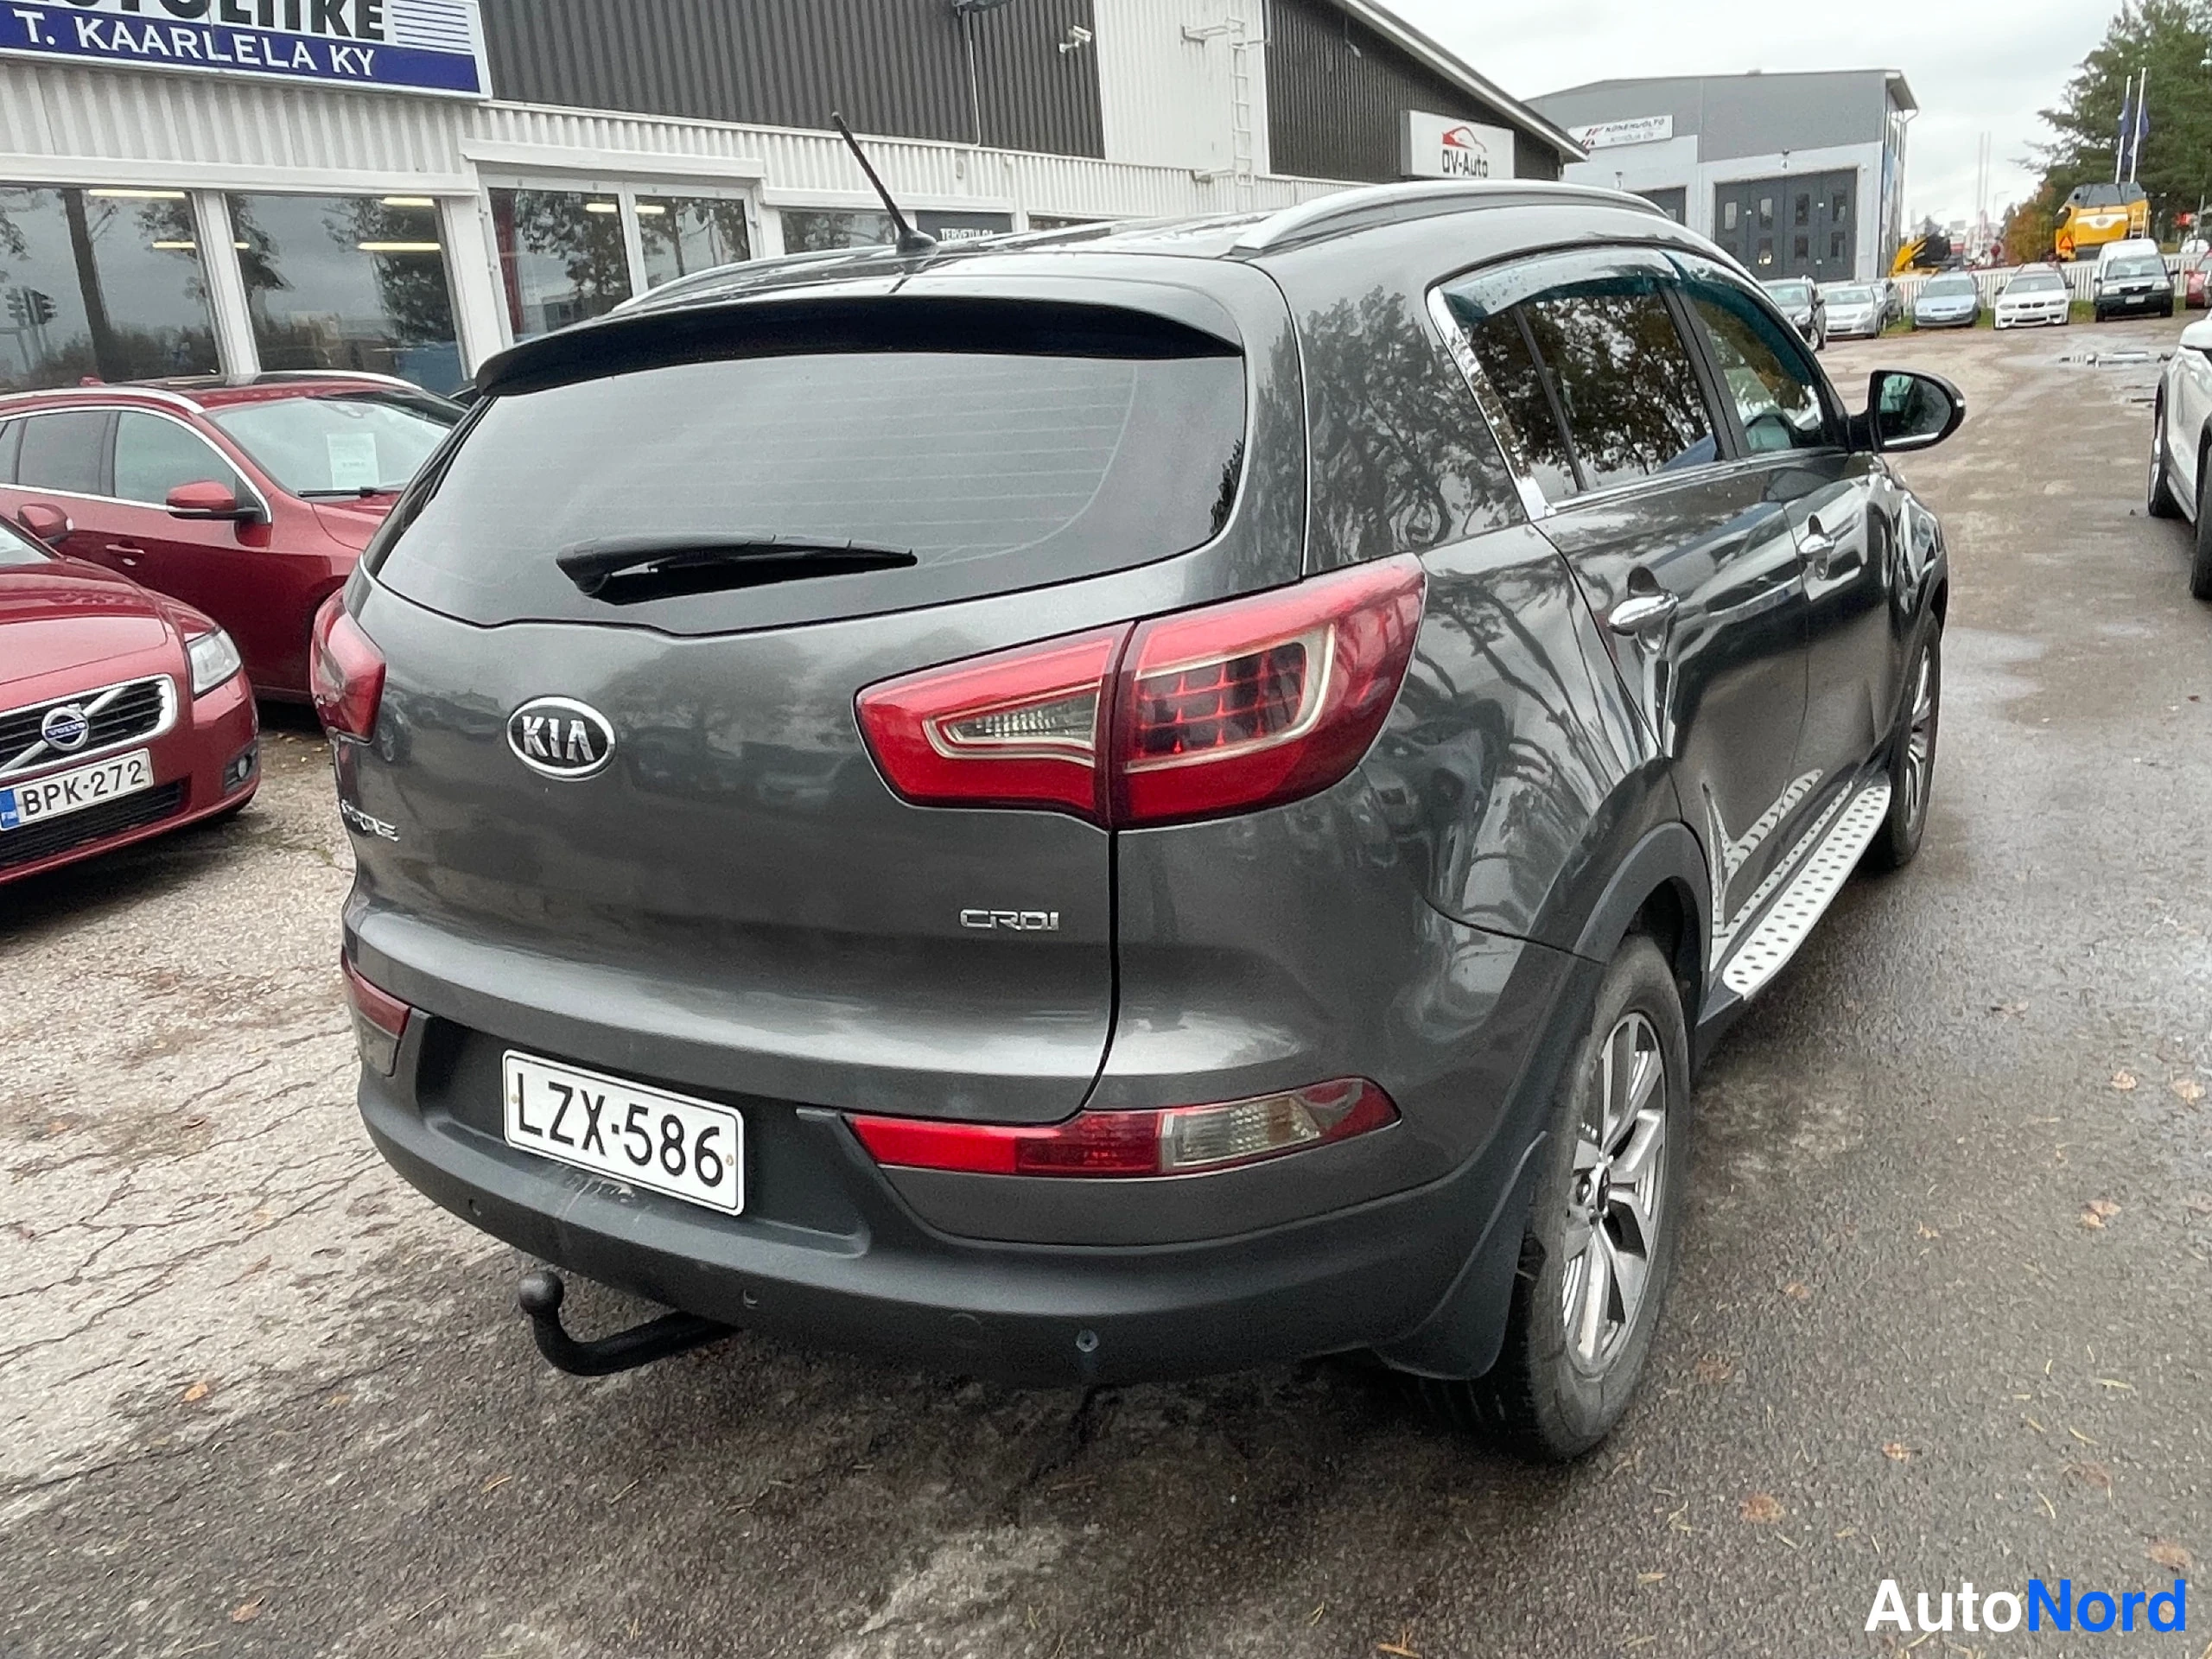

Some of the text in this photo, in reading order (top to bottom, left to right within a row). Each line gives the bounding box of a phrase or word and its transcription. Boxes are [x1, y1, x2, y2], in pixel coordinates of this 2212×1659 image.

[13, 8, 375, 77] T. KAARLELA KY
[47, 722, 86, 735] VOLVO
[521, 715, 594, 761] KIA
[22, 760, 145, 817] BPK-272
[960, 909, 1059, 931] CRDI
[518, 1072, 723, 1187] LZX-586
